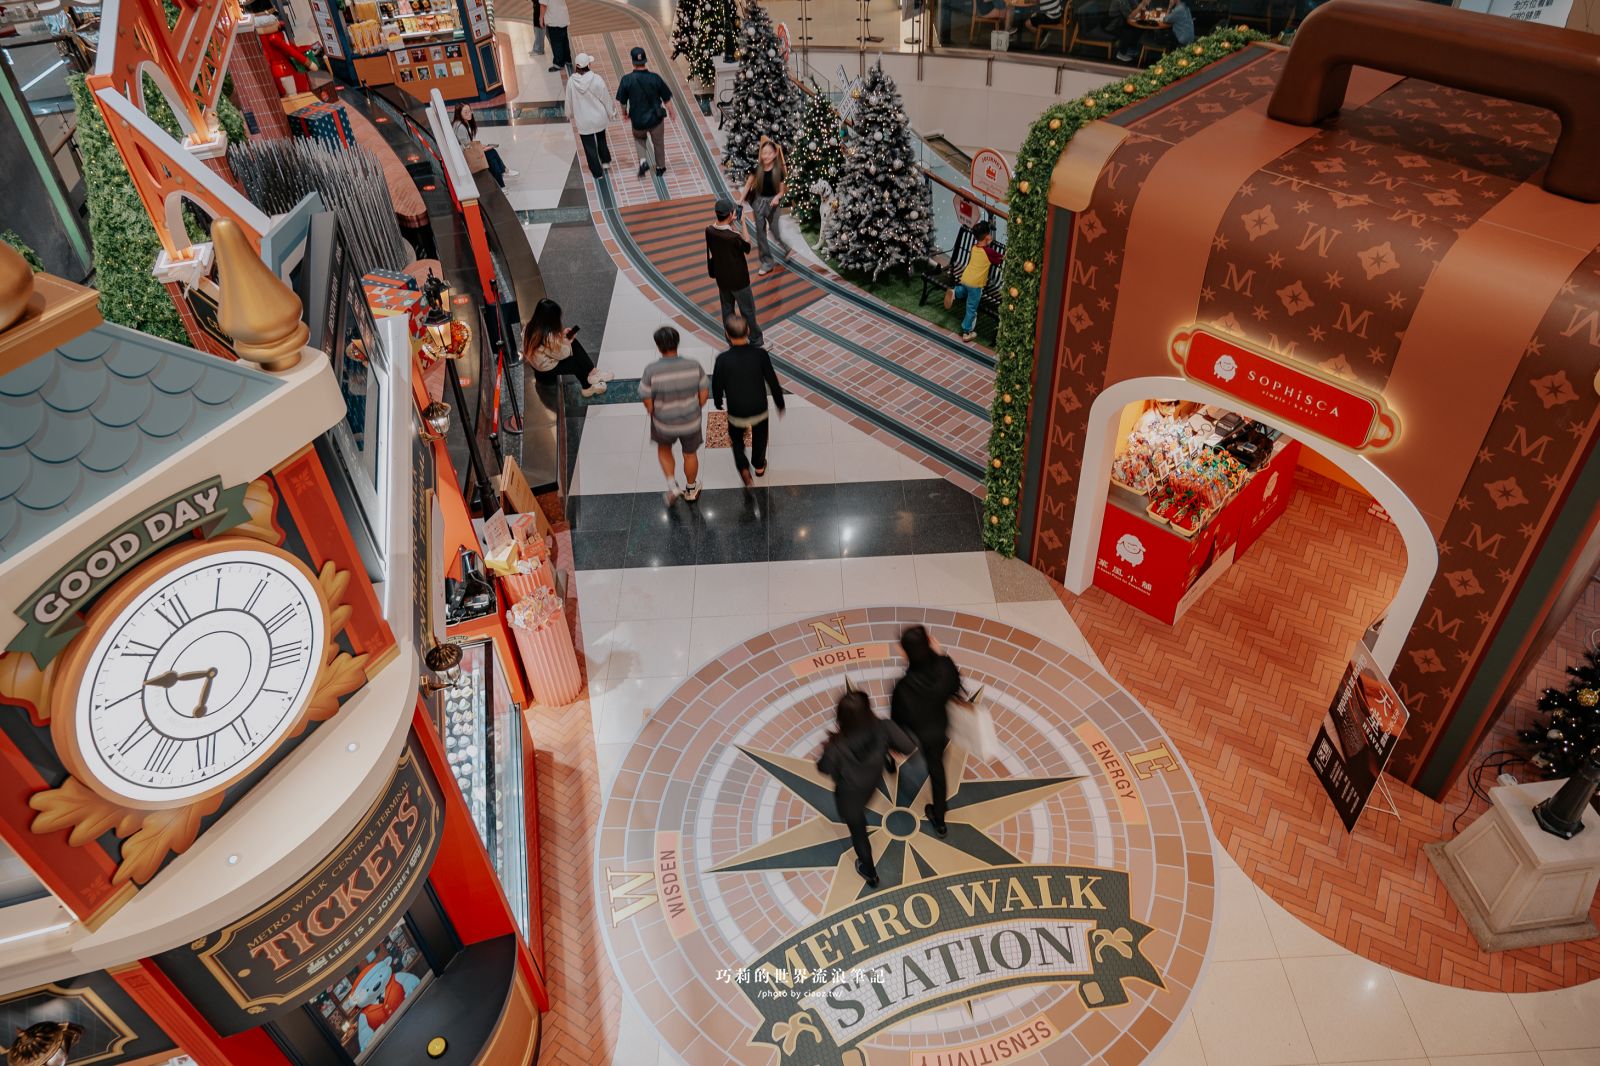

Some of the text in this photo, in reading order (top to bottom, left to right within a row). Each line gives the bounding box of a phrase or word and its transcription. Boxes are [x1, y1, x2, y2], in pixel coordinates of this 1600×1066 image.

[1222, 263, 1256, 298] M
[1332, 302, 1374, 339] M
[1503, 425, 1555, 464] M
[418, 451, 426, 545] TERMINAL
[33, 486, 220, 624] GOOD DAY
[807, 615, 851, 651] N
[812, 648, 867, 668] NOBLE
[1361, 721, 1384, 757] HEAVEN
[1366, 685, 1394, 738] 天堂
[1091, 741, 1137, 800] ENERGY
[1124, 742, 1180, 781] E
[246, 781, 410, 949] METRO WALK CENTRAL TERMINAL
[250, 792, 419, 972] TICKETS
[659, 849, 687, 919] WISDEN
[327, 867, 411, 961] LIFE IS A JOURNEY
[605, 865, 660, 929] W
[761, 874, 1107, 996] METRO WALK
[825, 925, 1078, 1030] STATION
